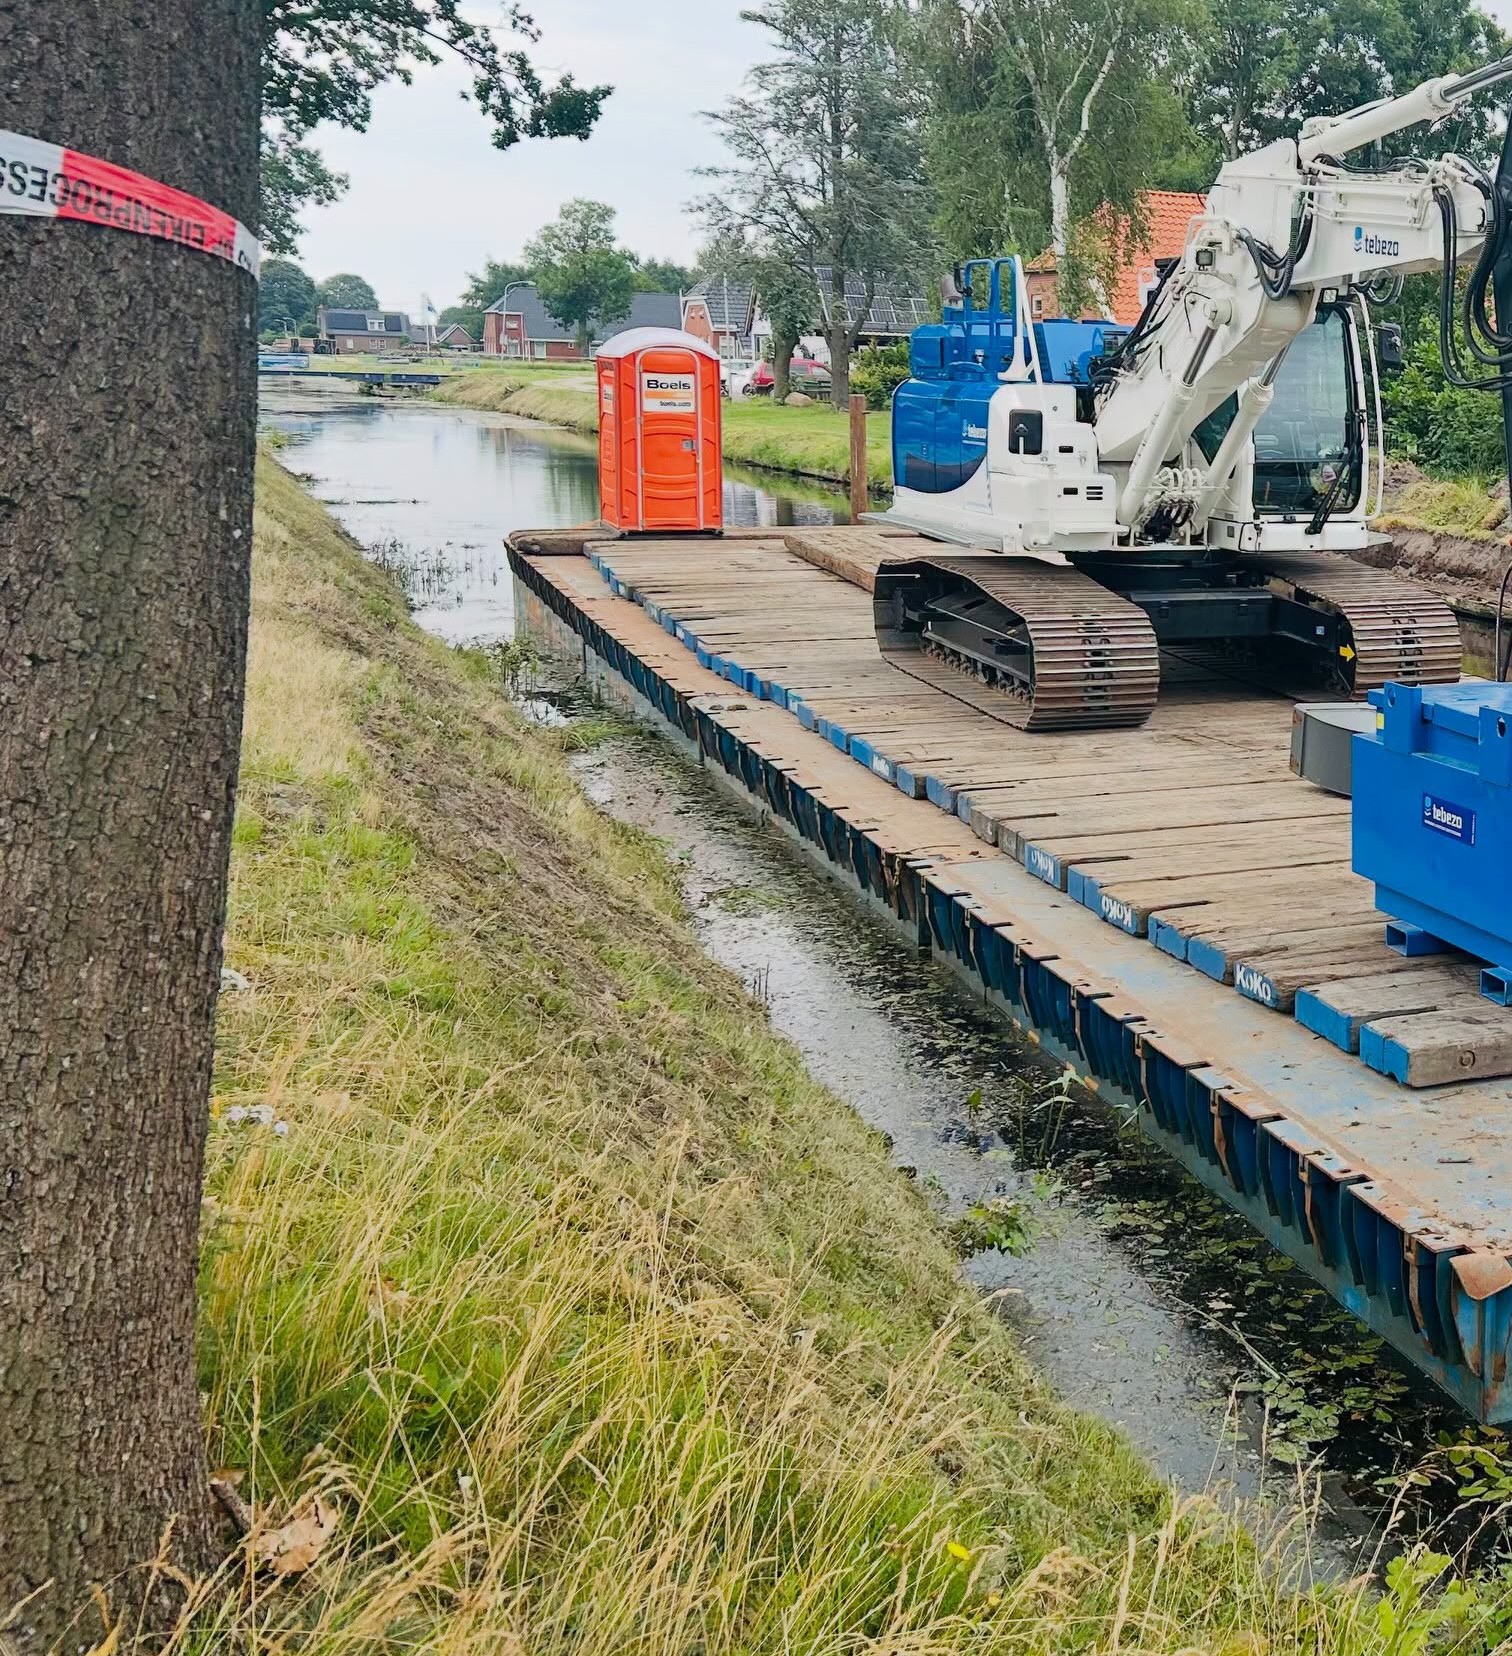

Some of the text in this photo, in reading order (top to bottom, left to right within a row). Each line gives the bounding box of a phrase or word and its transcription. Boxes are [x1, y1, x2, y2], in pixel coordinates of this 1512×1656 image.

[0, 156, 206, 246] EIKENPROCES
[1365, 235, 1399, 257] tebezo
[646, 379, 691, 390] Boels
[1432, 803, 1463, 829] tebezo
